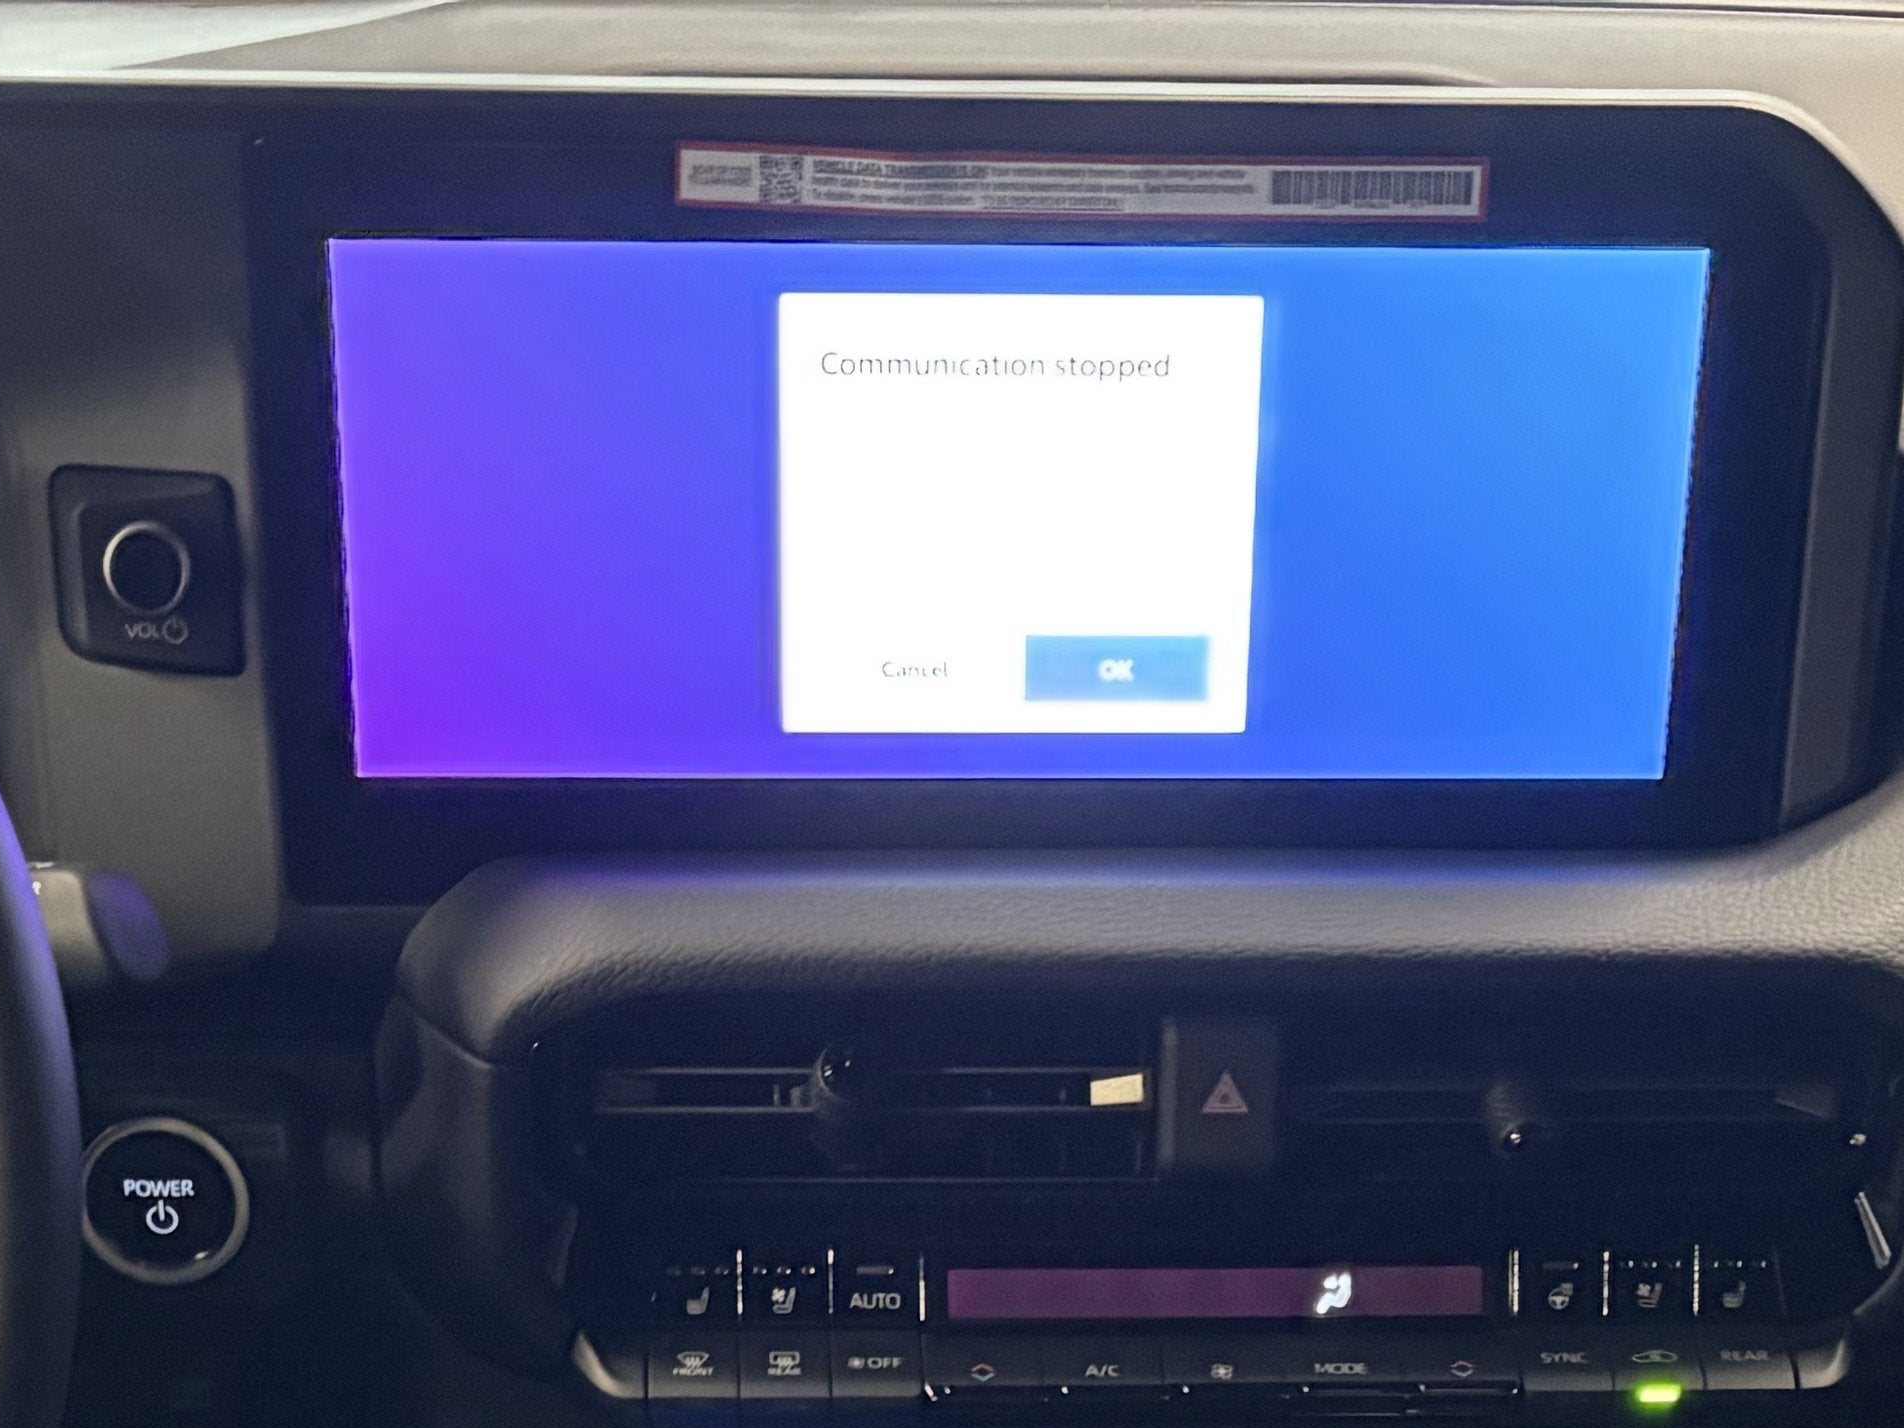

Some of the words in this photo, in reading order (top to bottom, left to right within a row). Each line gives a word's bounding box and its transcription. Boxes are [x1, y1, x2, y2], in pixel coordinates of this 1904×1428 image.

[821, 351, 1044, 376] Communication
[1054, 354, 1171, 381] stopped
[124, 623, 159, 640] VOL
[881, 661, 948, 679] Cancel
[1098, 658, 1135, 682] OK
[122, 1179, 195, 1198] POWER
[849, 1293, 901, 1310] AUTO
[867, 1356, 903, 1370] OFF
[1539, 1350, 1589, 1365] SYNC
[1085, 1363, 1119, 1379] A/C
[1313, 1361, 1368, 1376] MODE
